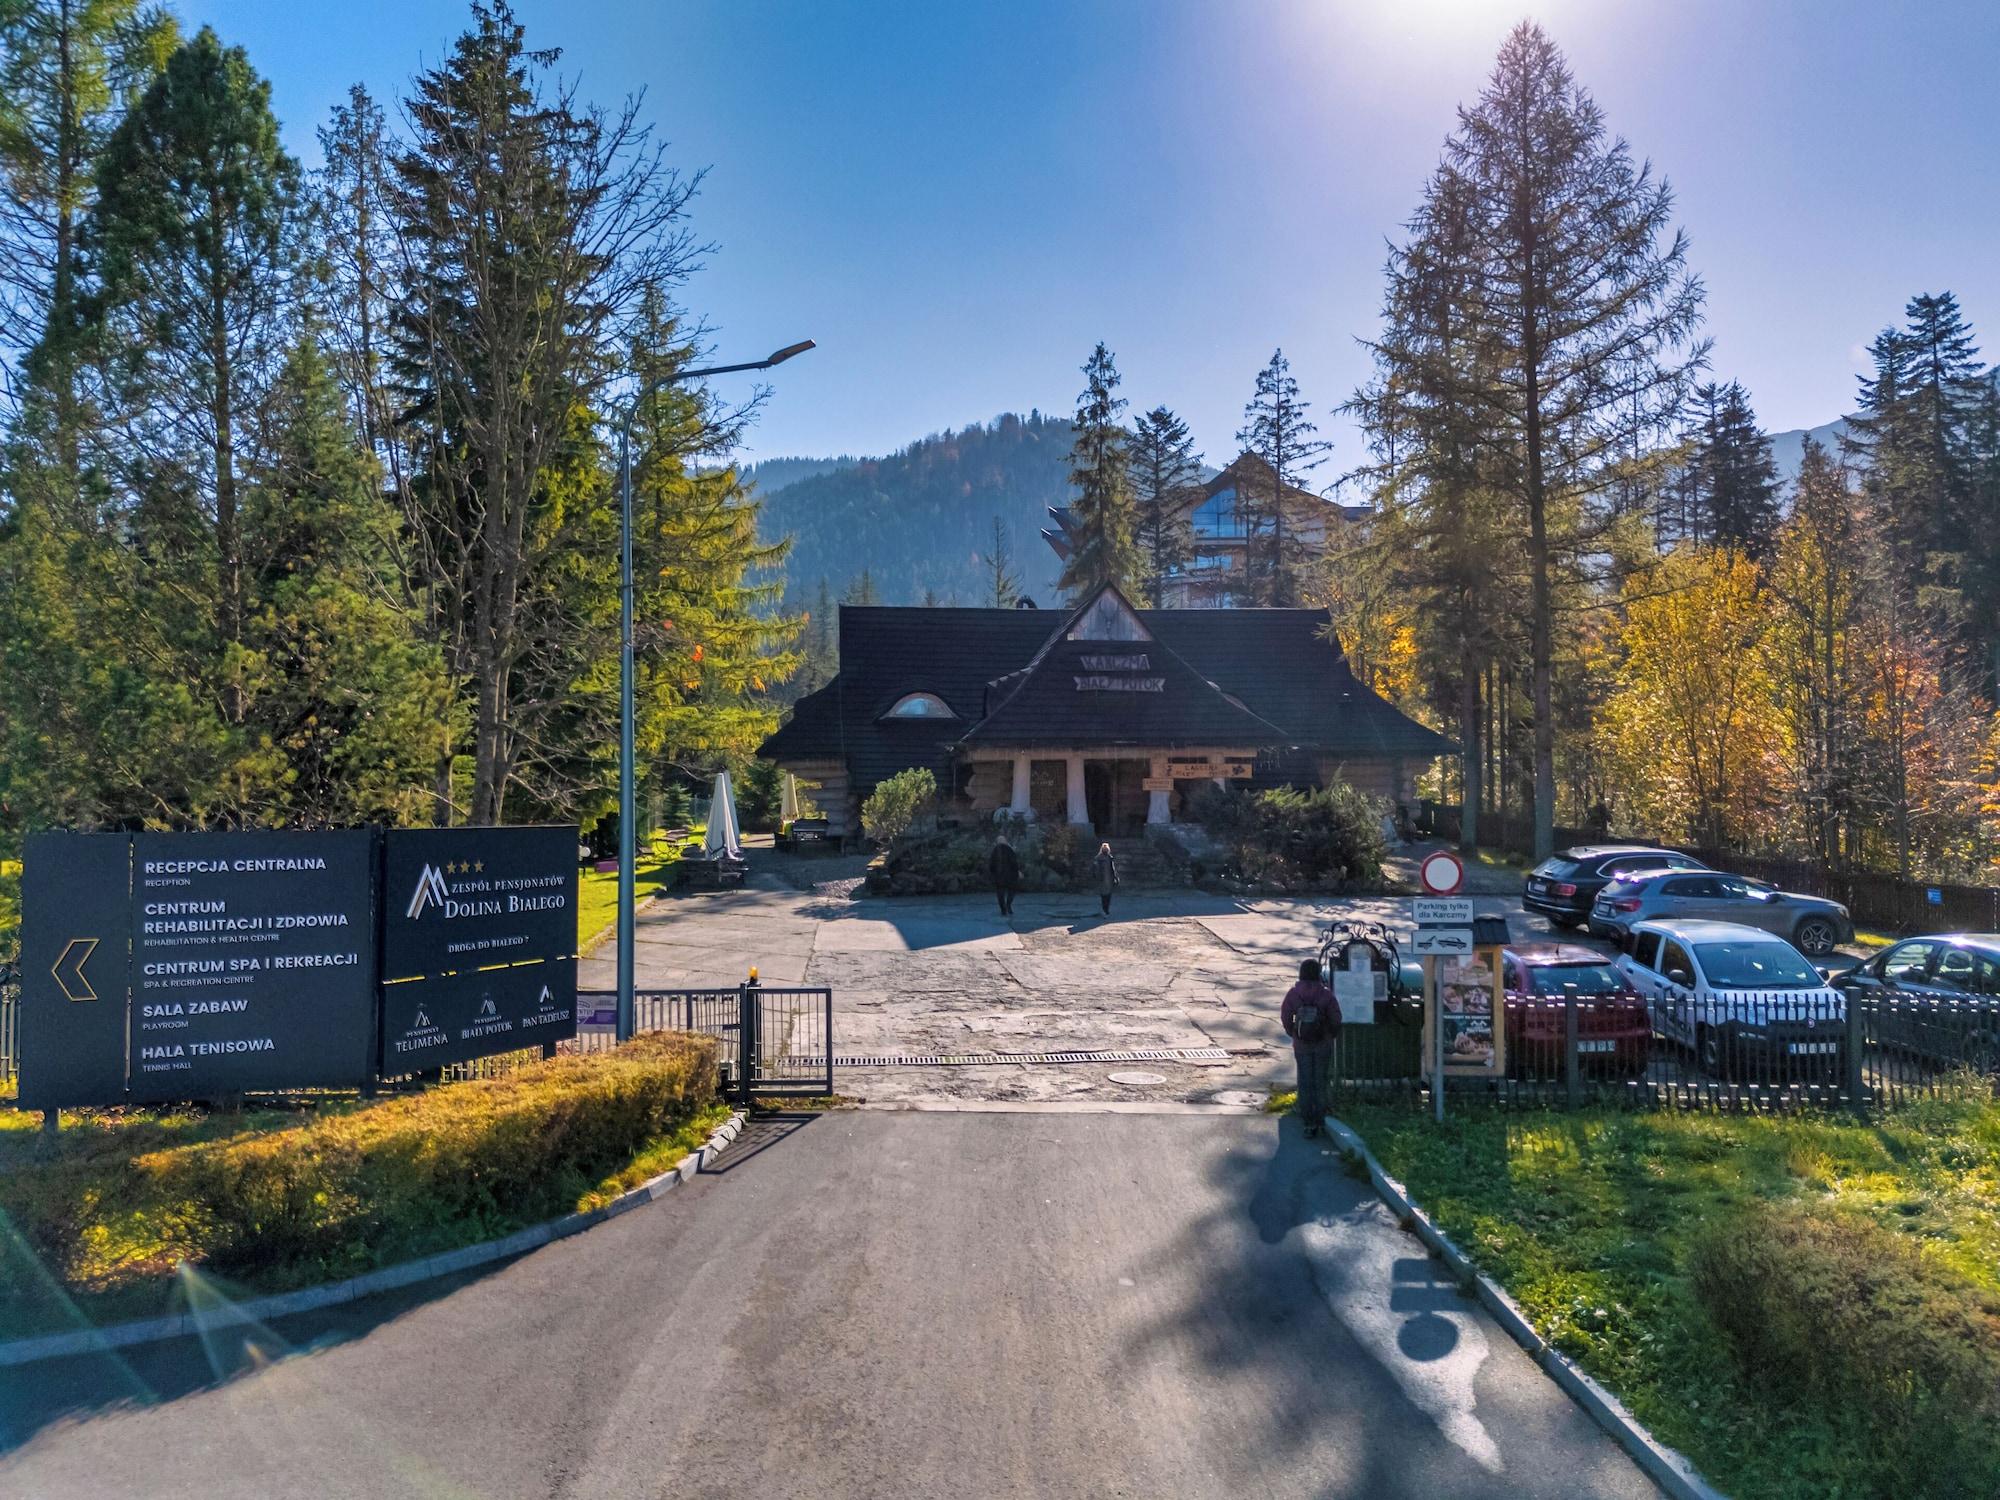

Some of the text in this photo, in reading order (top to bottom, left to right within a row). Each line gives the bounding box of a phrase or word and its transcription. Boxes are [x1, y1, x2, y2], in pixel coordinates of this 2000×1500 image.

[145, 858, 327, 874] RECEPCJA CENTRALNA
[145, 878, 191, 887] RECEPTION
[495, 875, 566, 891] PENSJONATÓW
[145, 901, 226, 915] CENTRUM
[445, 900, 502, 919] DOLINA
[1418, 911, 1467, 920] dla Karczmy
[144, 914, 349, 934] REHABILITACJI I ZDROWIA
[144, 933, 280, 947] REHABILITATION & HEALTH CENTRE
[448, 943, 476, 953] DROGA
[478, 940, 490, 950] DO
[143, 953, 358, 975] CENTRUM SPA I REKREACJI
[143, 975, 254, 989] SPA & RECREATION CENTRE
[143, 1000, 248, 1017] SALA ZABAW
[143, 1020, 189, 1031] PLAYROOM
[142, 1039, 275, 1059] HALA TENISOWA
[395, 1033, 449, 1053] TELIMENA
[143, 1061, 193, 1073] TENNIS HALL
